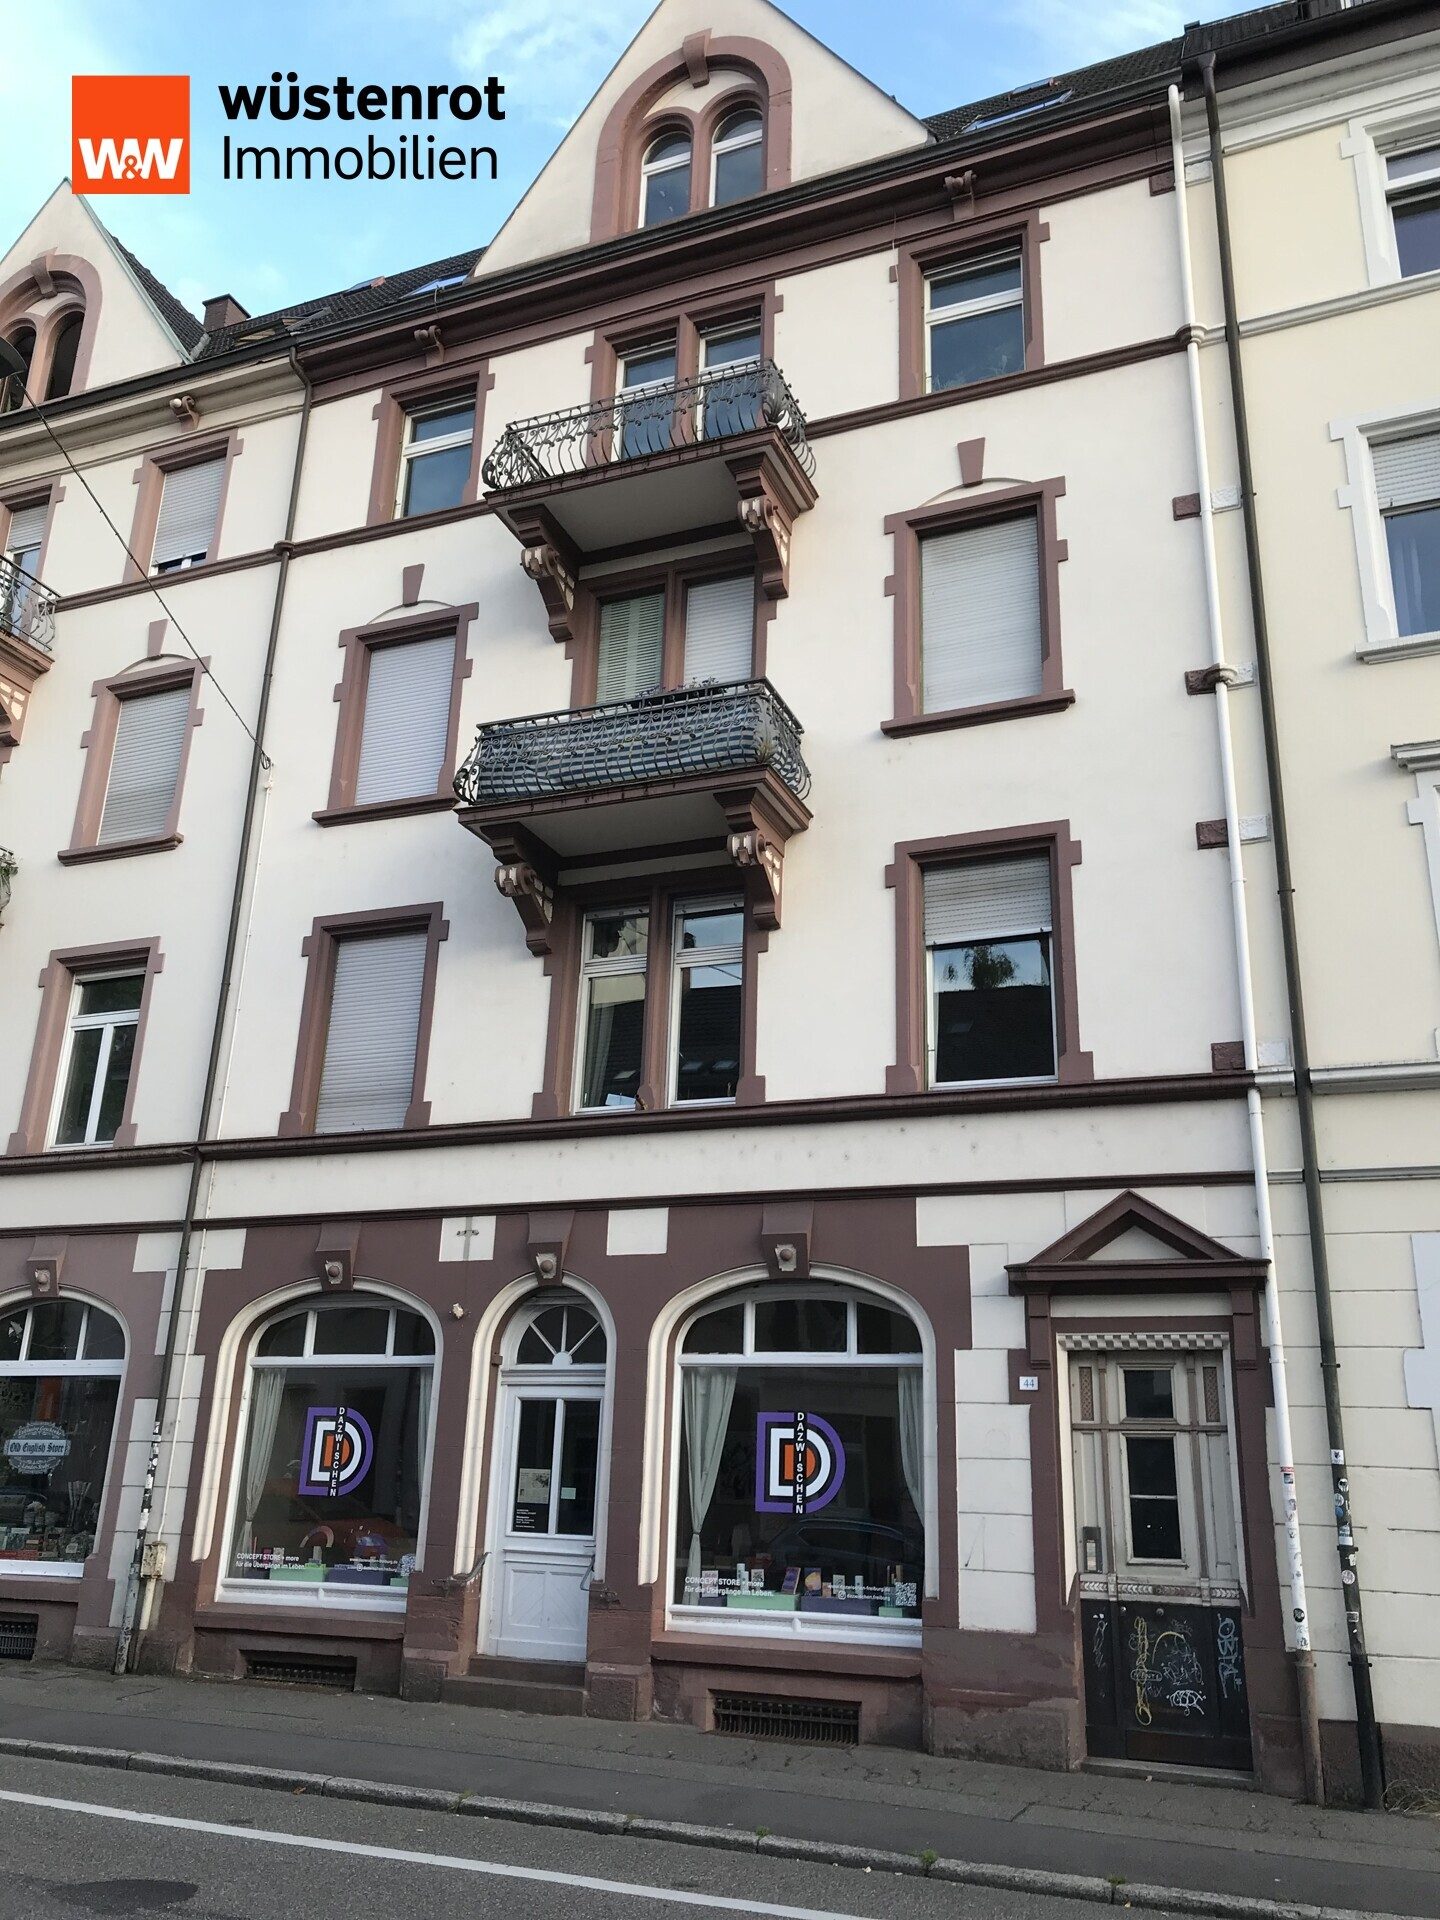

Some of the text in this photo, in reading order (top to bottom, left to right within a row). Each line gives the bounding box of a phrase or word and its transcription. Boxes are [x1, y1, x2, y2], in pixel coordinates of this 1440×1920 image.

[1023, 1379, 1035, 1388] 44
[9, 1442, 65, 1455] Old English Store
[329, 1407, 346, 1497] DAZWISCHEN
[795, 1412, 806, 1514] DAZWISCHEN
[236, 1552, 263, 1560] CONCEPT
[685, 1576, 718, 1586] CONCEPT
[718, 1578, 741, 1587] STORE
[684, 1585, 695, 1593] für
[705, 1586, 741, 1596] Übergänge
